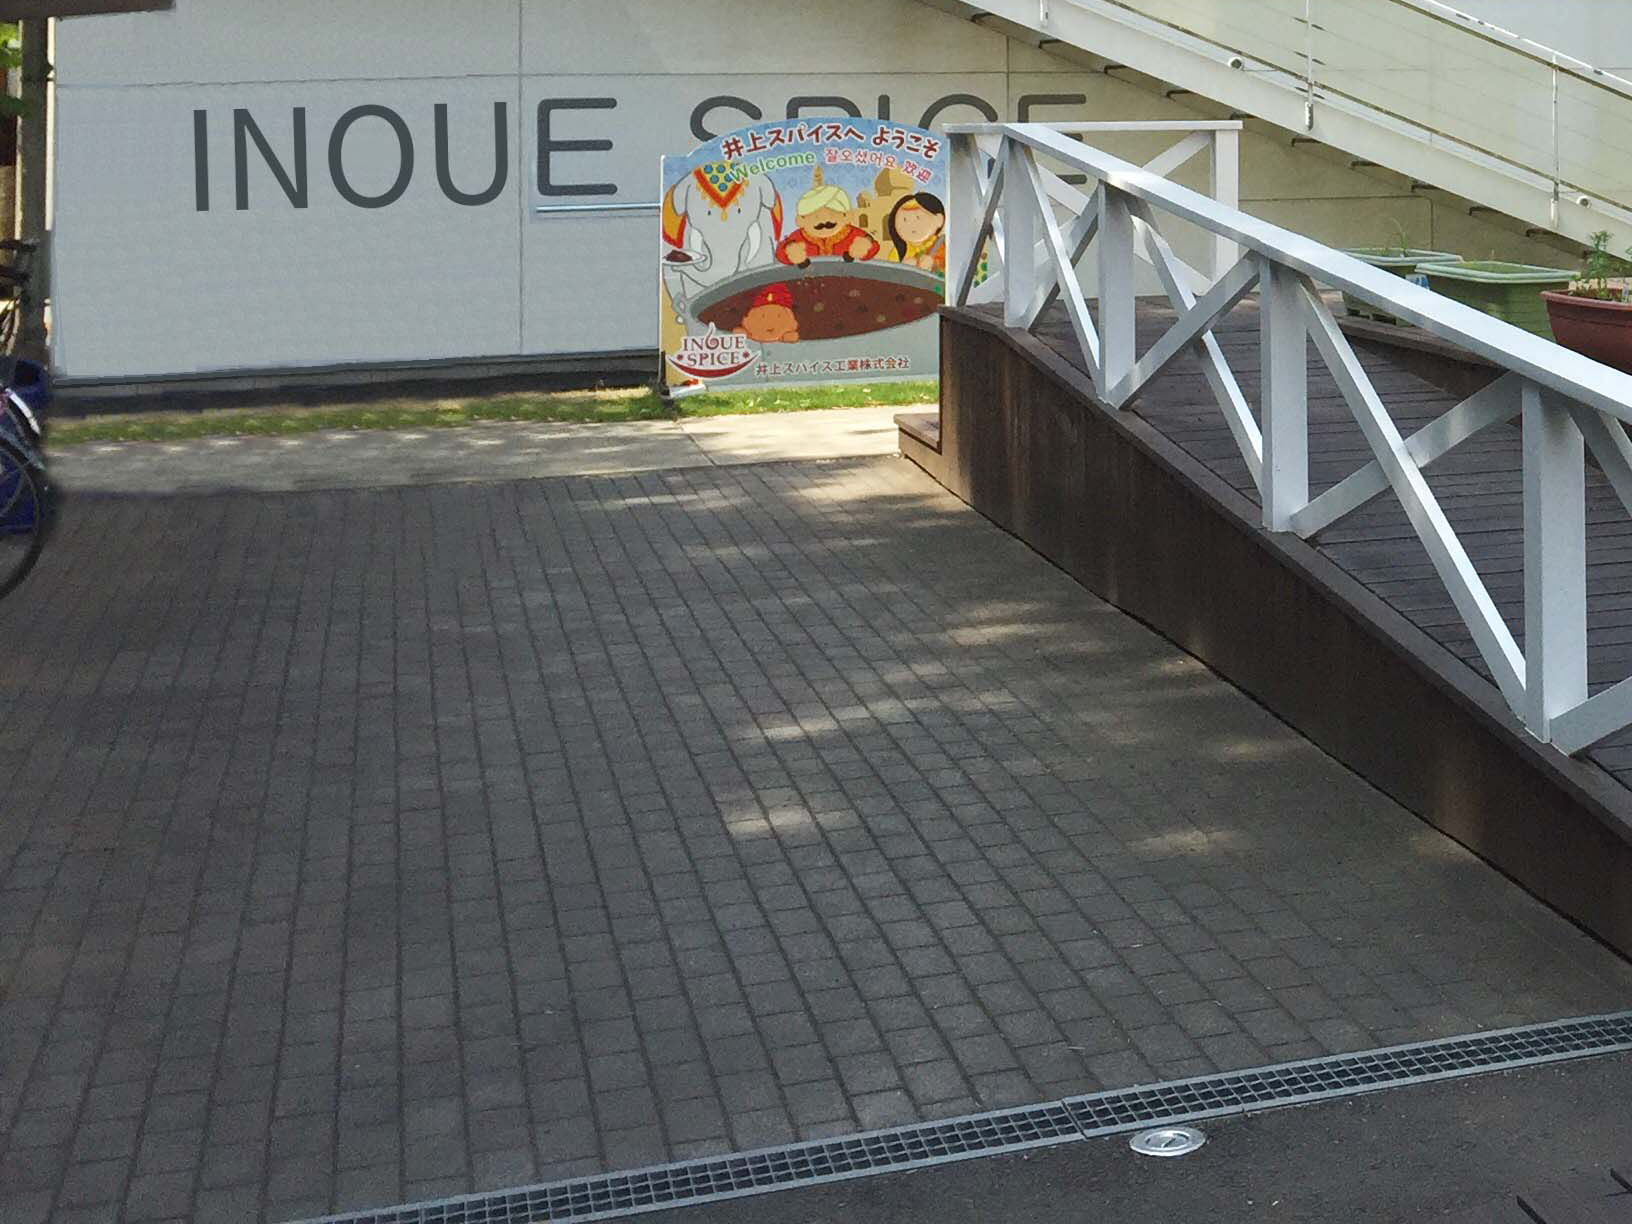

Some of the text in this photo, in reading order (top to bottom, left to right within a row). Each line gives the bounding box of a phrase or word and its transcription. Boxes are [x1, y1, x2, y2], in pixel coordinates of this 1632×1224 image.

[192, 96, 618, 212] INOUE
[722, 123, 941, 159] 井上スパイスへ ようこそ
[729, 151, 816, 182] Welcome
[682, 331, 746, 352] INOUE
[687, 351, 743, 366] SPICE
